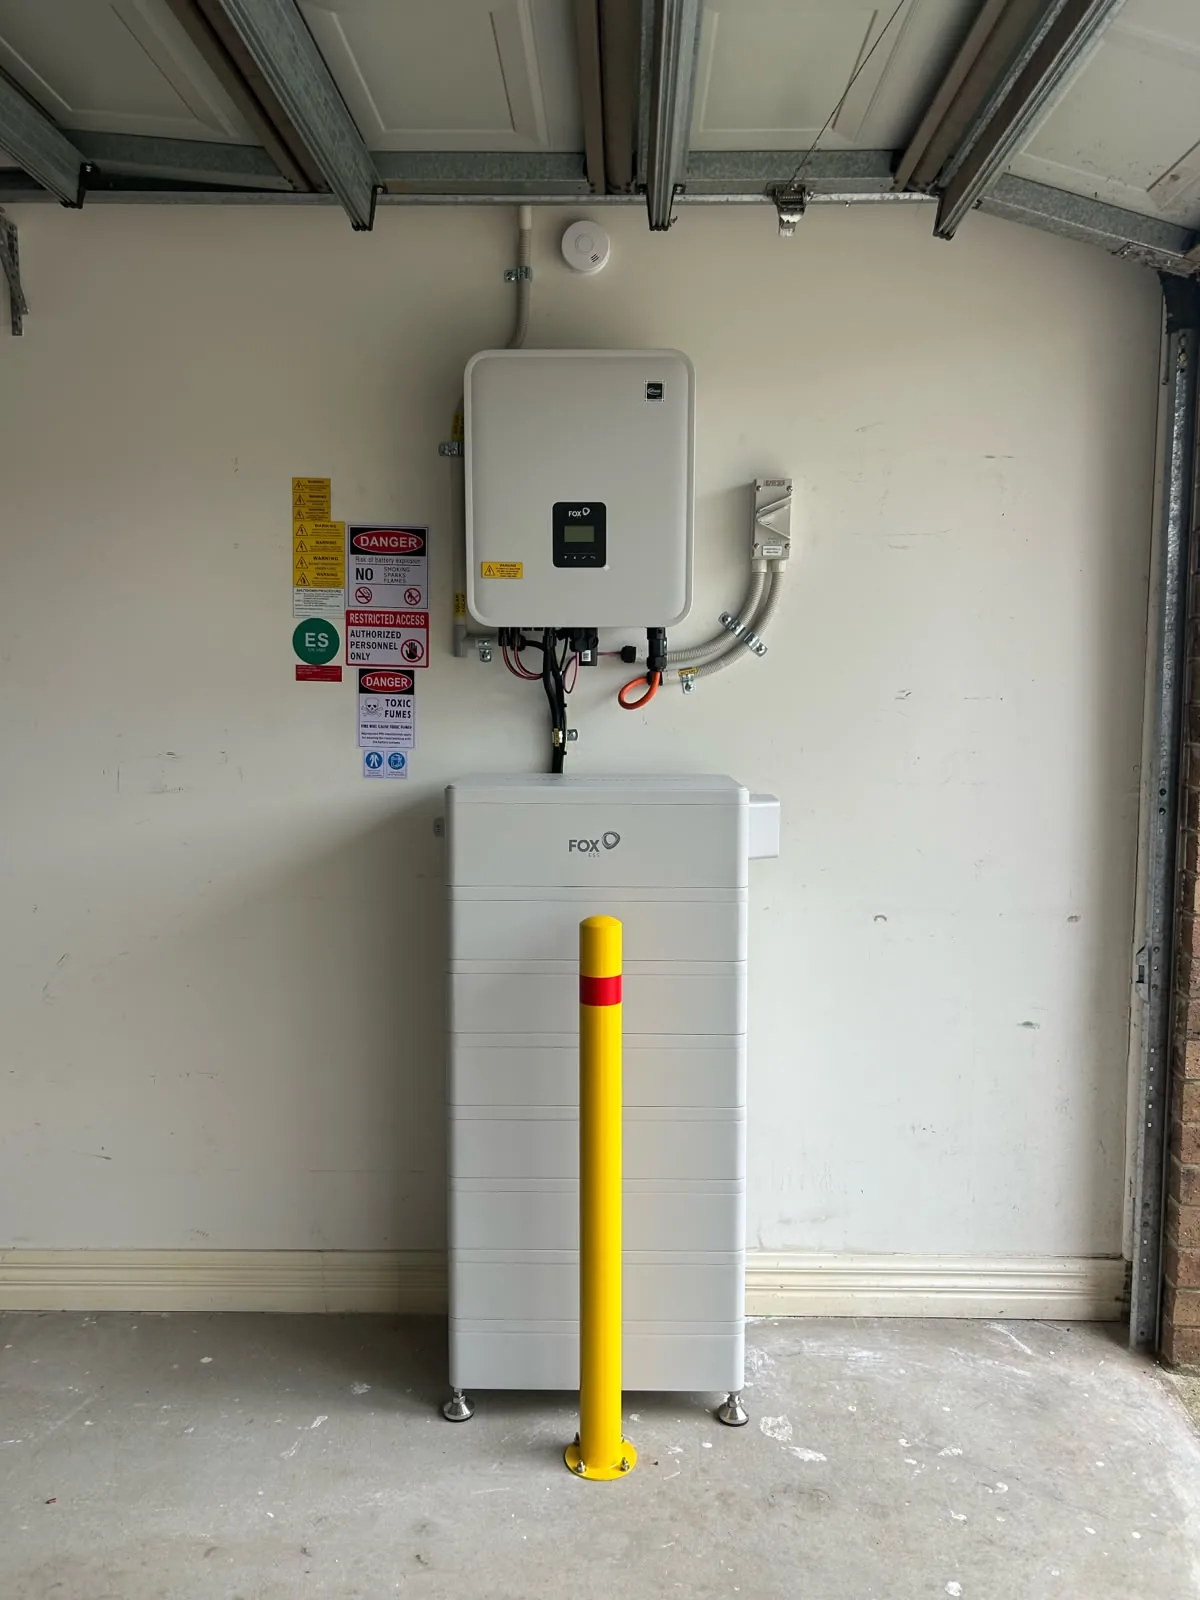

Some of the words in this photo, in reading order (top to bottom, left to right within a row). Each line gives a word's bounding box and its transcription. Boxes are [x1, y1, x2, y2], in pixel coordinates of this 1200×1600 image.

[360, 536, 417, 548] DANGER
[375, 556, 394, 564] battery
[356, 568, 374, 580] NO
[349, 613, 394, 625] RESTRICTED
[395, 614, 425, 626] ACCESS
[305, 632, 329, 648] ES
[350, 630, 402, 639] AUTHORIZED
[350, 641, 398, 650] PERSONNEL
[350, 652, 371, 661] ONLY
[366, 676, 408, 688] DANGER
[385, 698, 411, 708] TOXIC
[384, 710, 412, 719] FUMES
[568, 839, 600, 852] FOX
